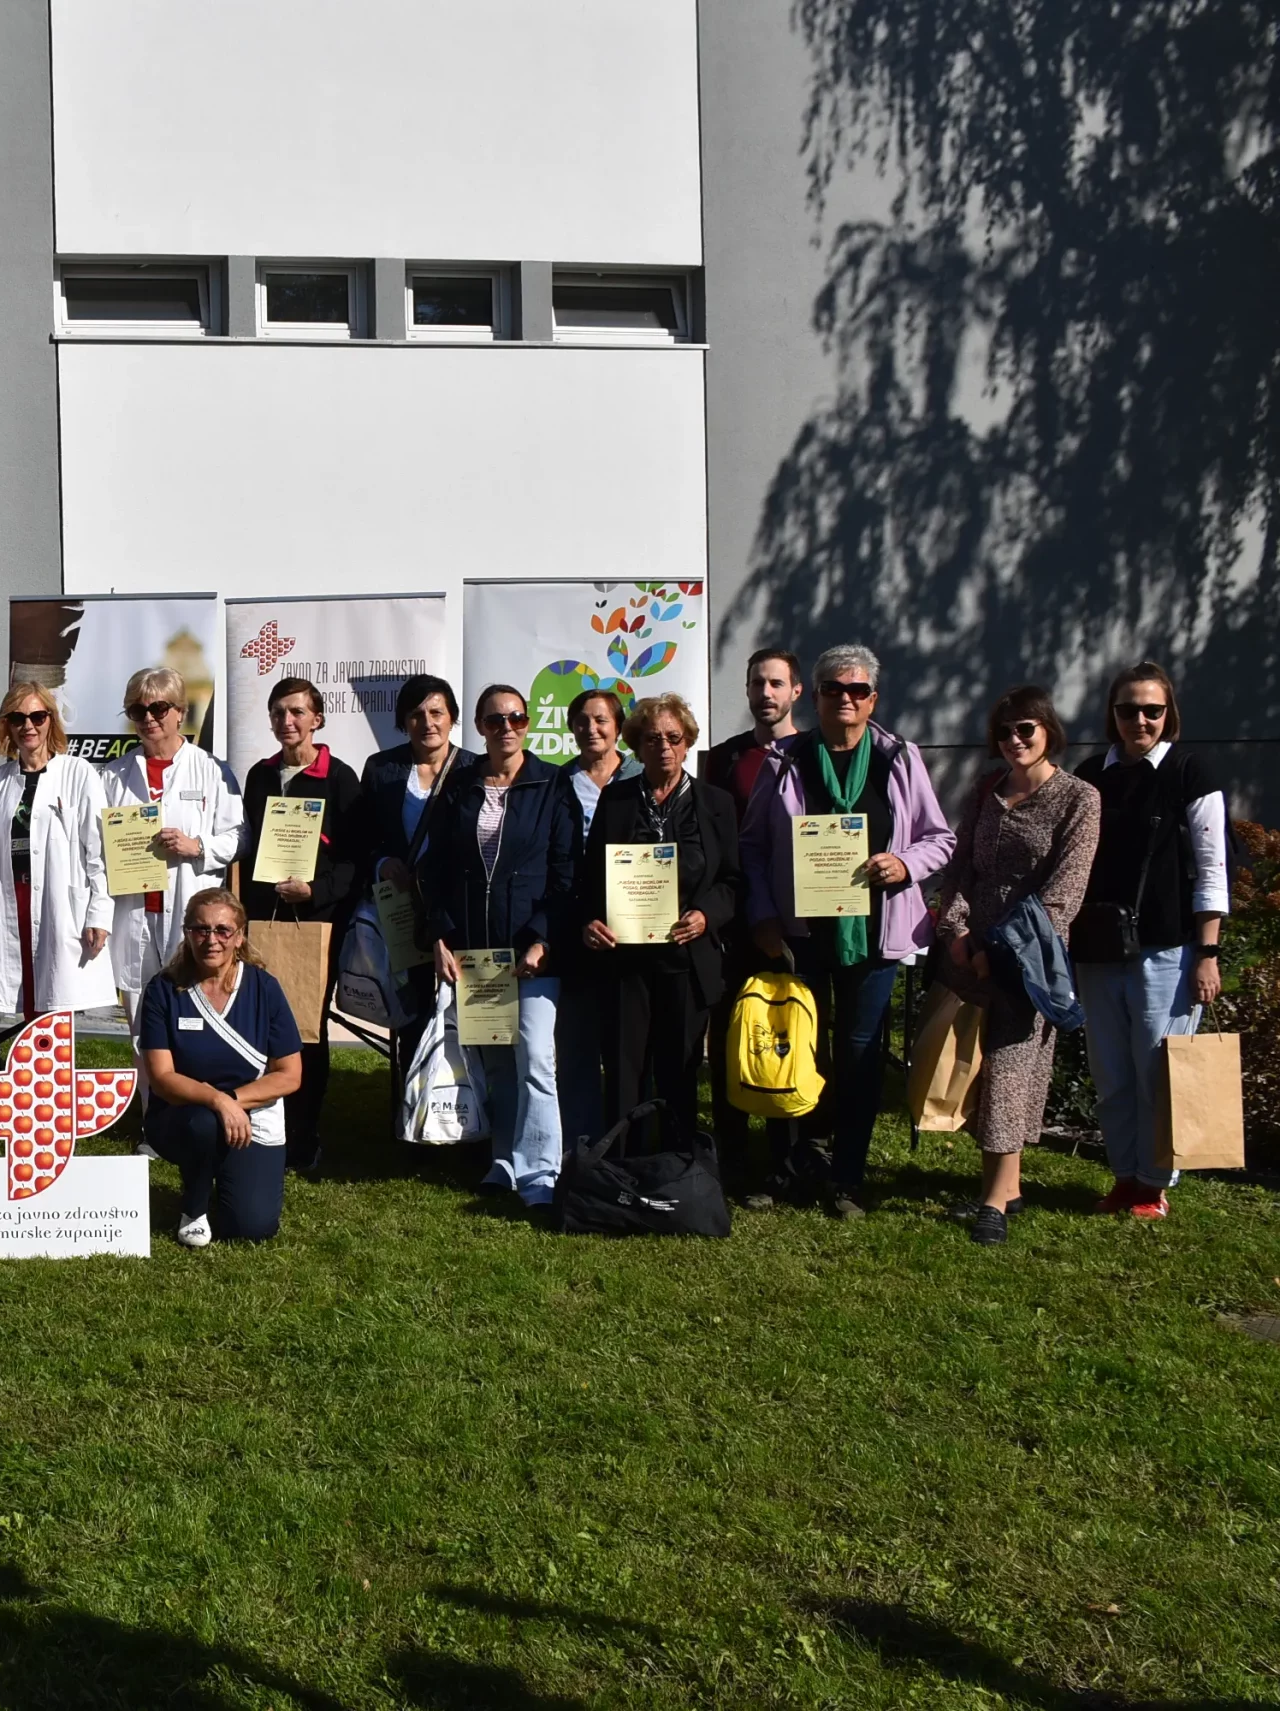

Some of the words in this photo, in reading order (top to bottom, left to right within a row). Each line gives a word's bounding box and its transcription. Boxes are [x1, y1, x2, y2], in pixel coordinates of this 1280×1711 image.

[316, 662, 328, 683] ZA
[333, 661, 364, 683] JAVNO
[66, 739, 142, 758] #BEAC
[14, 1207, 60, 1225] javno
[64, 1207, 138, 1220] zdravstvo
[56, 1224, 122, 1243] županije
